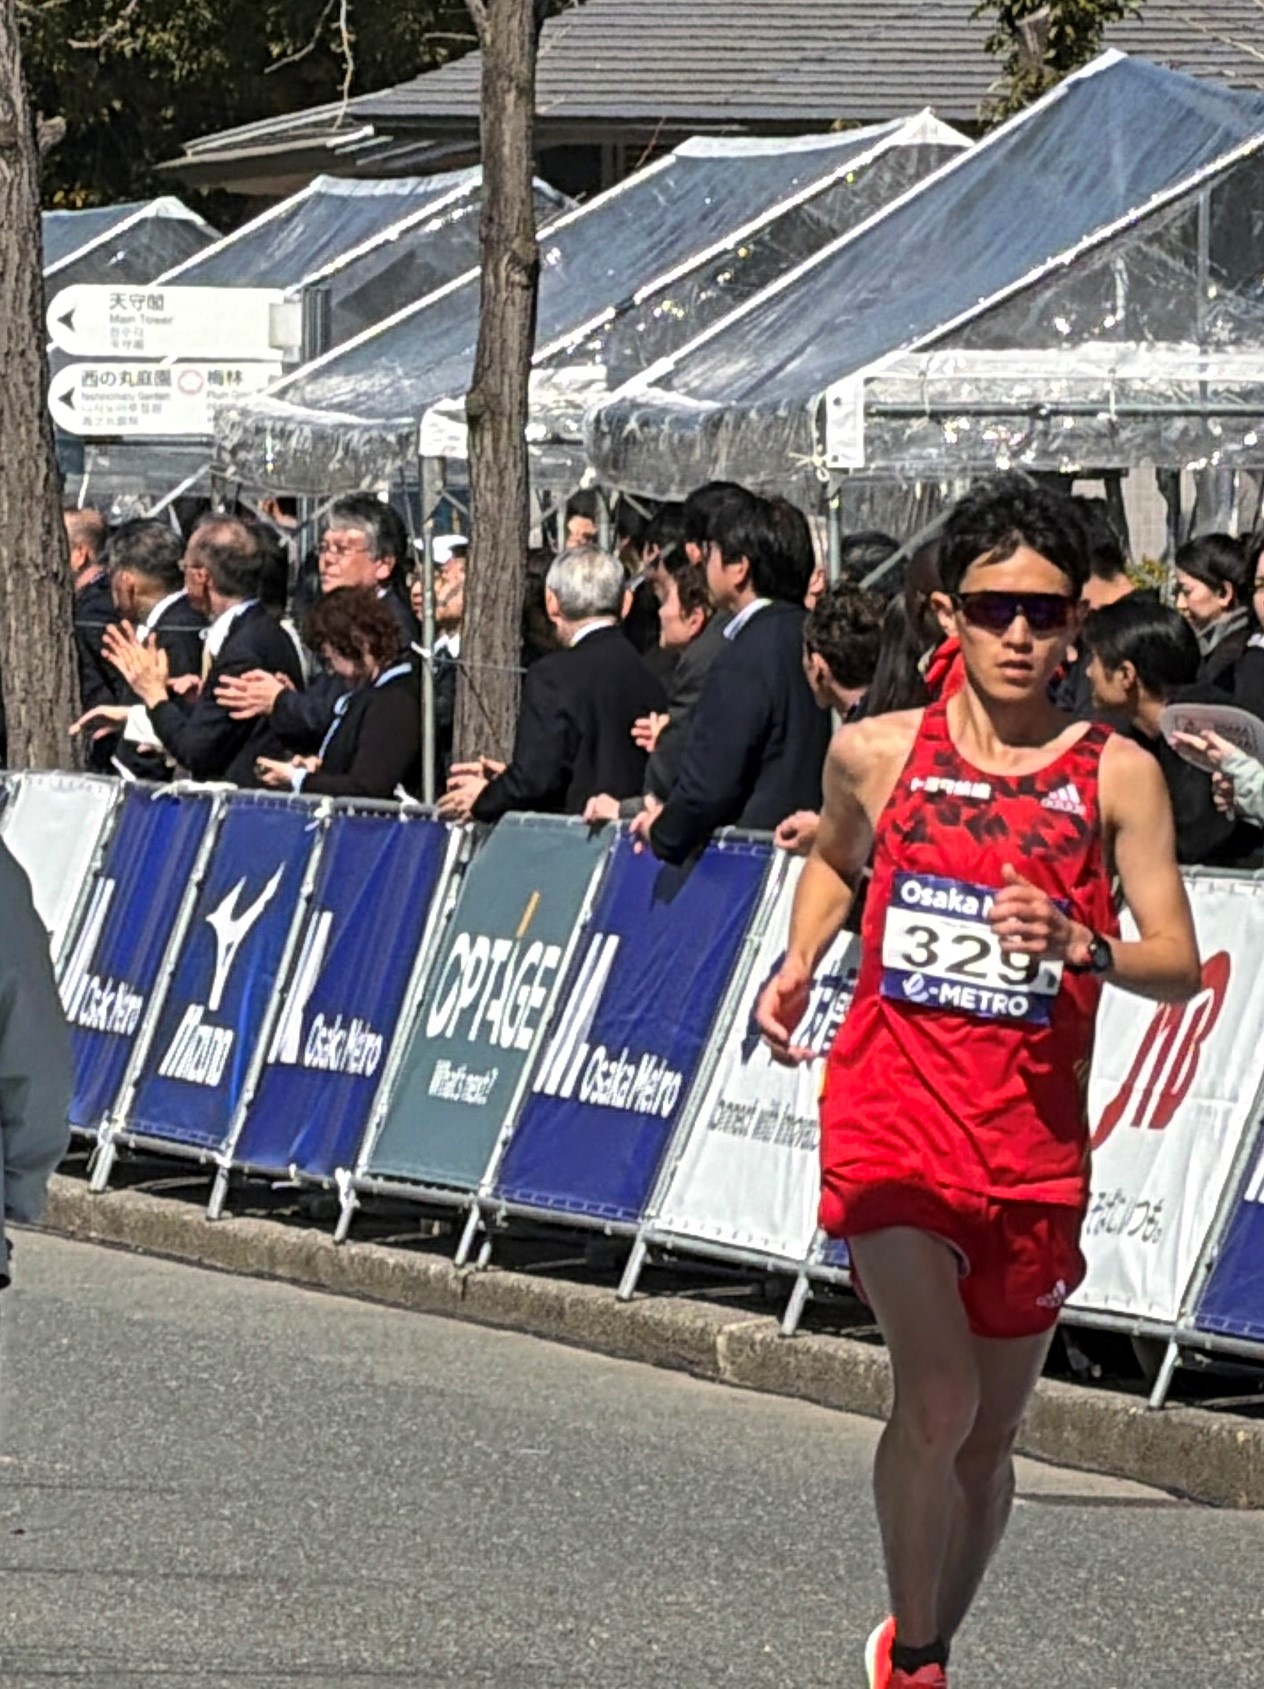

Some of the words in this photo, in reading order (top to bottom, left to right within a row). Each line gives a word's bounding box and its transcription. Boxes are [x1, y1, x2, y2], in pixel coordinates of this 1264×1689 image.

[110, 293, 164, 311] 天守閣
[141, 313, 174, 325] Tower
[81, 369, 171, 387] 西の丸庭園
[901, 880, 979, 916] Osaka
[304, 1013, 348, 1071] Osaka
[338, 1018, 384, 1077] Metro
[579, 1045, 636, 1109] Osaka
[628, 1053, 682, 1118] Metro
